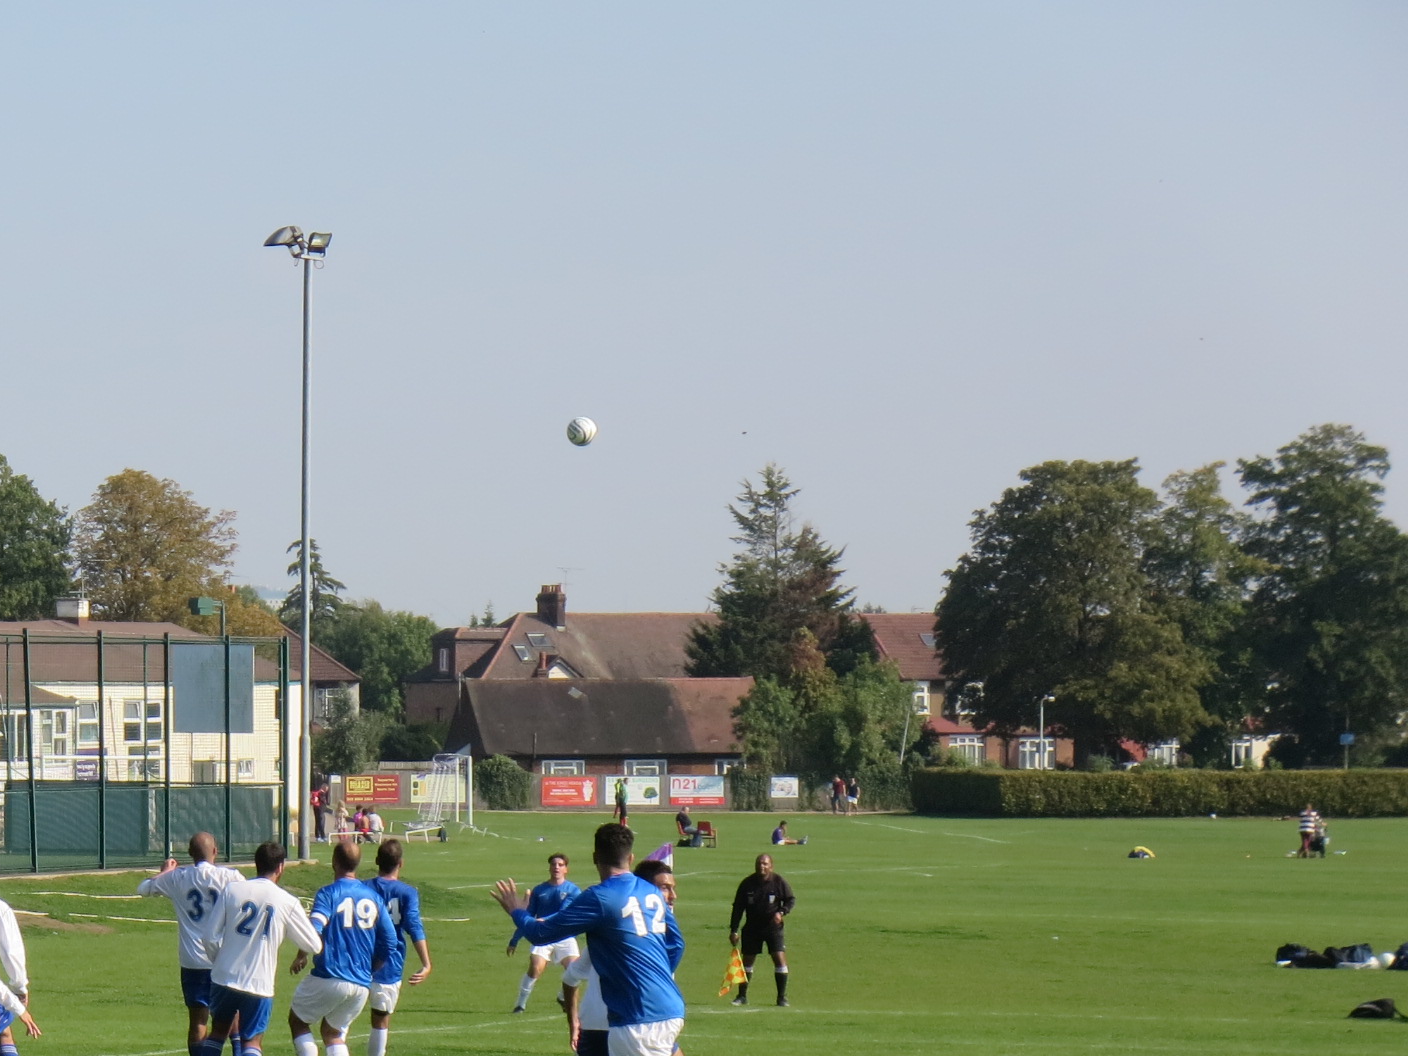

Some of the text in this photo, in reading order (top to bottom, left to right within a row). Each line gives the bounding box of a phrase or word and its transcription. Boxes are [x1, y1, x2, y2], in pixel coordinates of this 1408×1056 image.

[235, 900, 276, 938] 21
[337, 897, 378, 929] 19
[621, 893, 666, 937] 12
